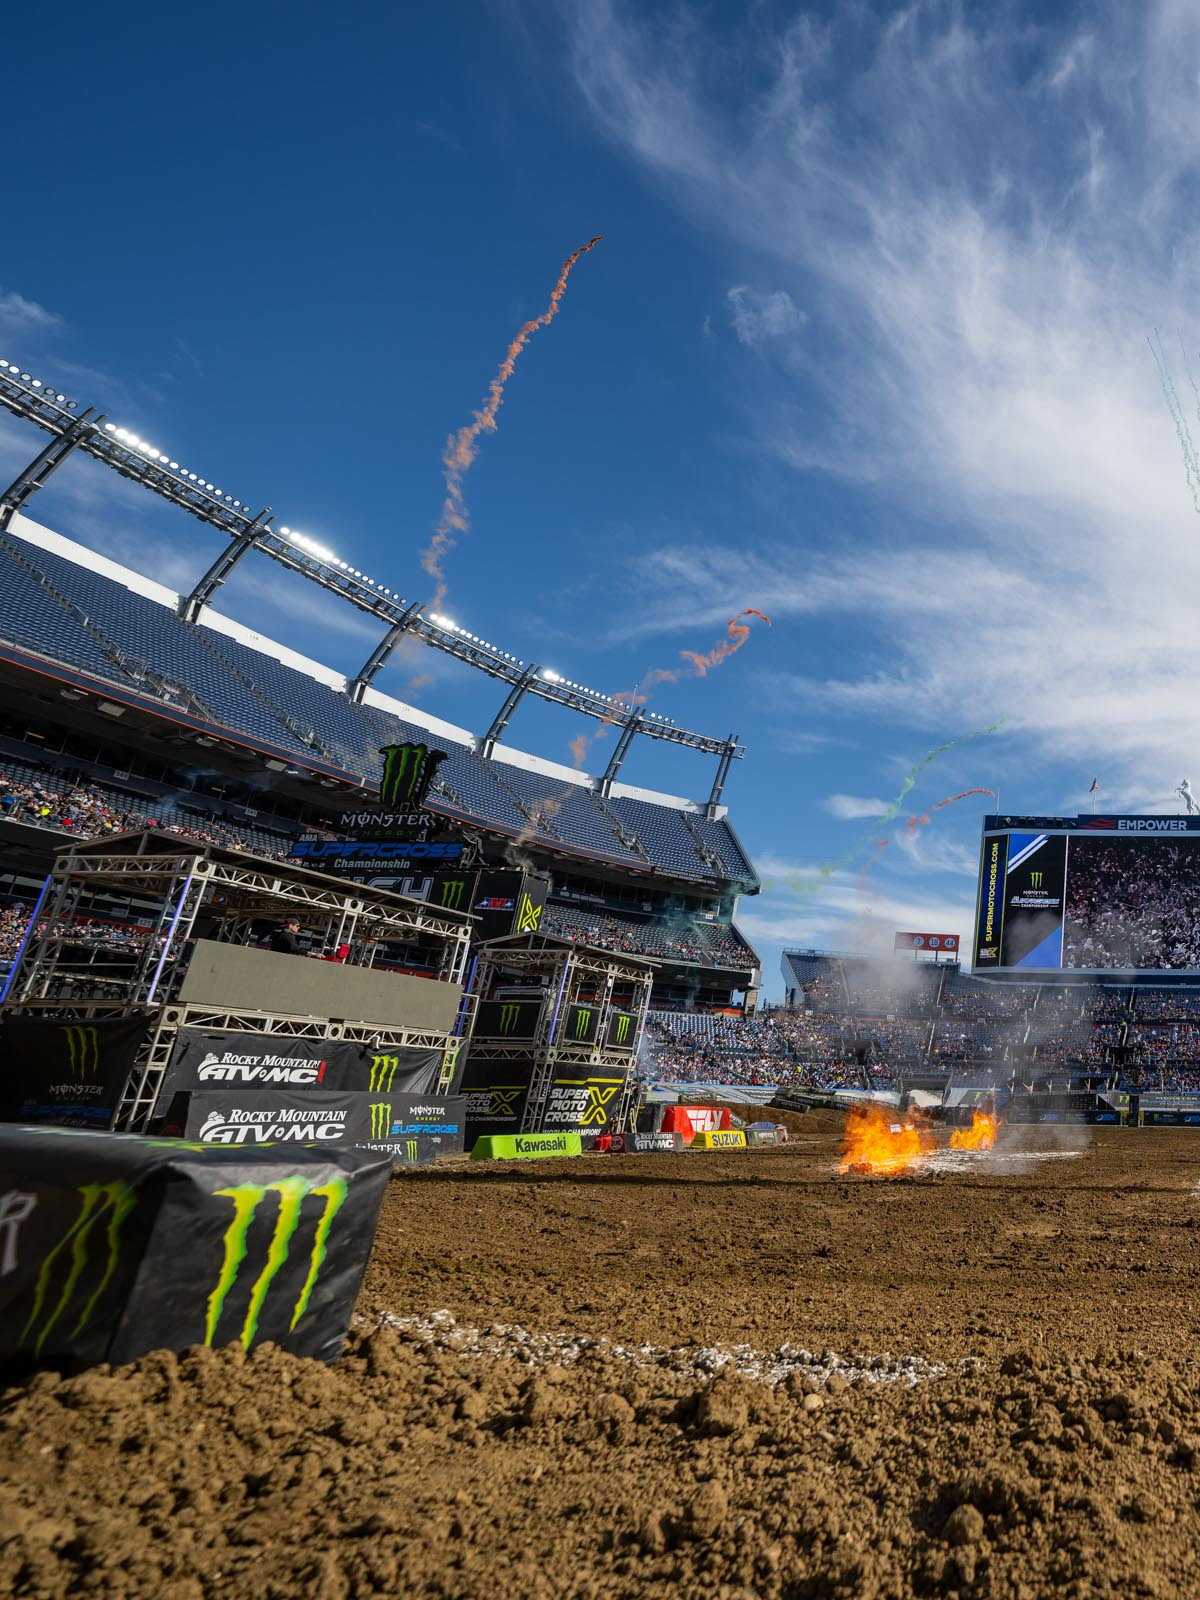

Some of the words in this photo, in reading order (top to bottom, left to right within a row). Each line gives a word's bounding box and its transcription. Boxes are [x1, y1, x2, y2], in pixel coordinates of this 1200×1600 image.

[340, 812, 431, 827] MONSTER
[1118, 820, 1187, 830] EMPOWER
[300, 834, 318, 842] AMA
[291, 842, 463, 857] SUPERCROSS
[334, 858, 410, 869] Championship
[986, 843, 999, 942] SUPERMOTOCROSS.COM
[221, 1052, 259, 1066] ROCKY
[260, 1055, 321, 1068] MOUNTAIN
[49, 1083, 104, 1095] MONSTER
[550, 1088, 590, 1100] SUPER
[410, 1105, 446, 1115] MONSTER
[550, 1100, 586, 1110] MOTO
[228, 1109, 276, 1123] ROCKY
[276, 1108, 348, 1122] MOUNTAIN
[544, 1112, 584, 1122] CROSS
[686, 1110, 722, 1132] FLY
[391, 1124, 459, 1134] SUPERCROSS
[515, 1137, 566, 1153] Kawasaki
[712, 1134, 742, 1146] SUZUKI
[354, 1143, 402, 1155] STER
